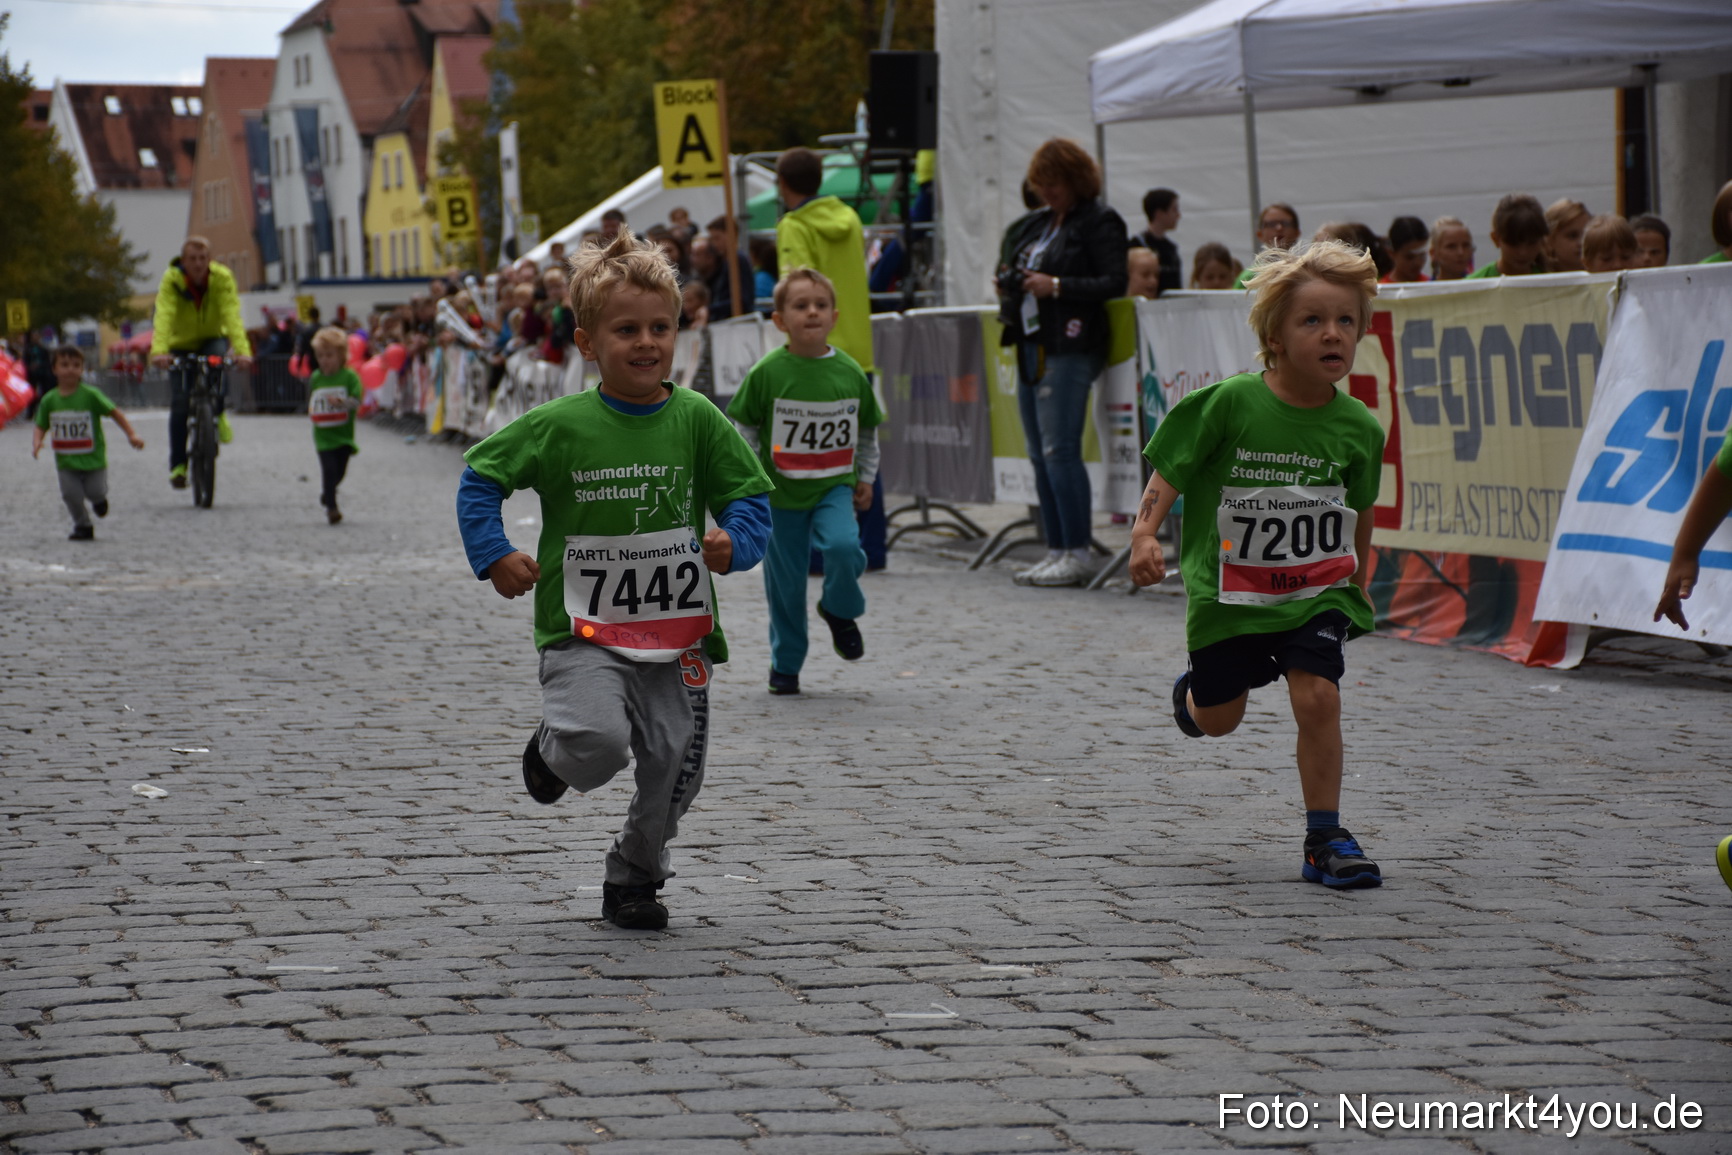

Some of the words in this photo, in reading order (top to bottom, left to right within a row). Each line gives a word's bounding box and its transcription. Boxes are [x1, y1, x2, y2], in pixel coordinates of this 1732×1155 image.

[662, 86, 714, 106] Block
[676, 113, 714, 164] A
[447, 198, 469, 227] B
[54, 422, 87, 438] 7102
[783, 419, 851, 450] 7423
[1236, 447, 1325, 468] Neumarkter
[571, 463, 668, 484] Neumarkter
[1230, 465, 1304, 486] Stadtlauf
[574, 482, 649, 503] Stadtlauf
[1222, 498, 1265, 511] PARTL
[1232, 510, 1343, 561] 7200
[567, 549, 615, 561] PARTL
[619, 543, 687, 561] Neumarkt
[580, 561, 704, 617] 7442
[1271, 573, 1308, 591] Max
[599, 625, 660, 649] Georg
[1317, 630, 1338, 642] adidas
